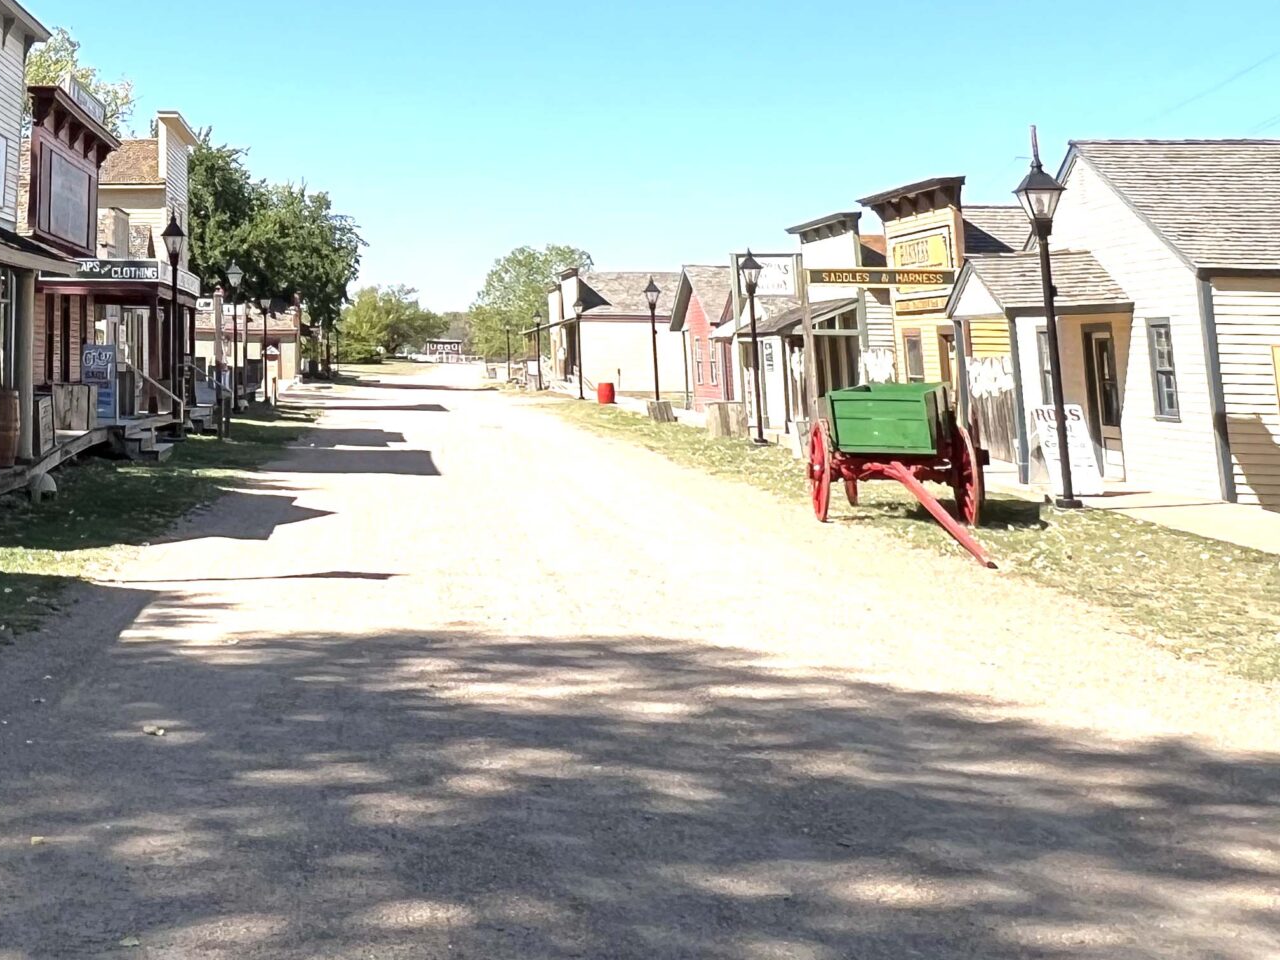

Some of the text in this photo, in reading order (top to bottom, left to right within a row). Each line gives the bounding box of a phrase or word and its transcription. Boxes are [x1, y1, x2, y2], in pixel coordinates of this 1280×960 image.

[77, 261, 101, 272] APS
[111, 267, 158, 278] CLOTHING
[822, 272, 870, 283] SADDLES
[895, 273, 943, 284] HARNESS
[1035, 408, 1081, 422] ROS
